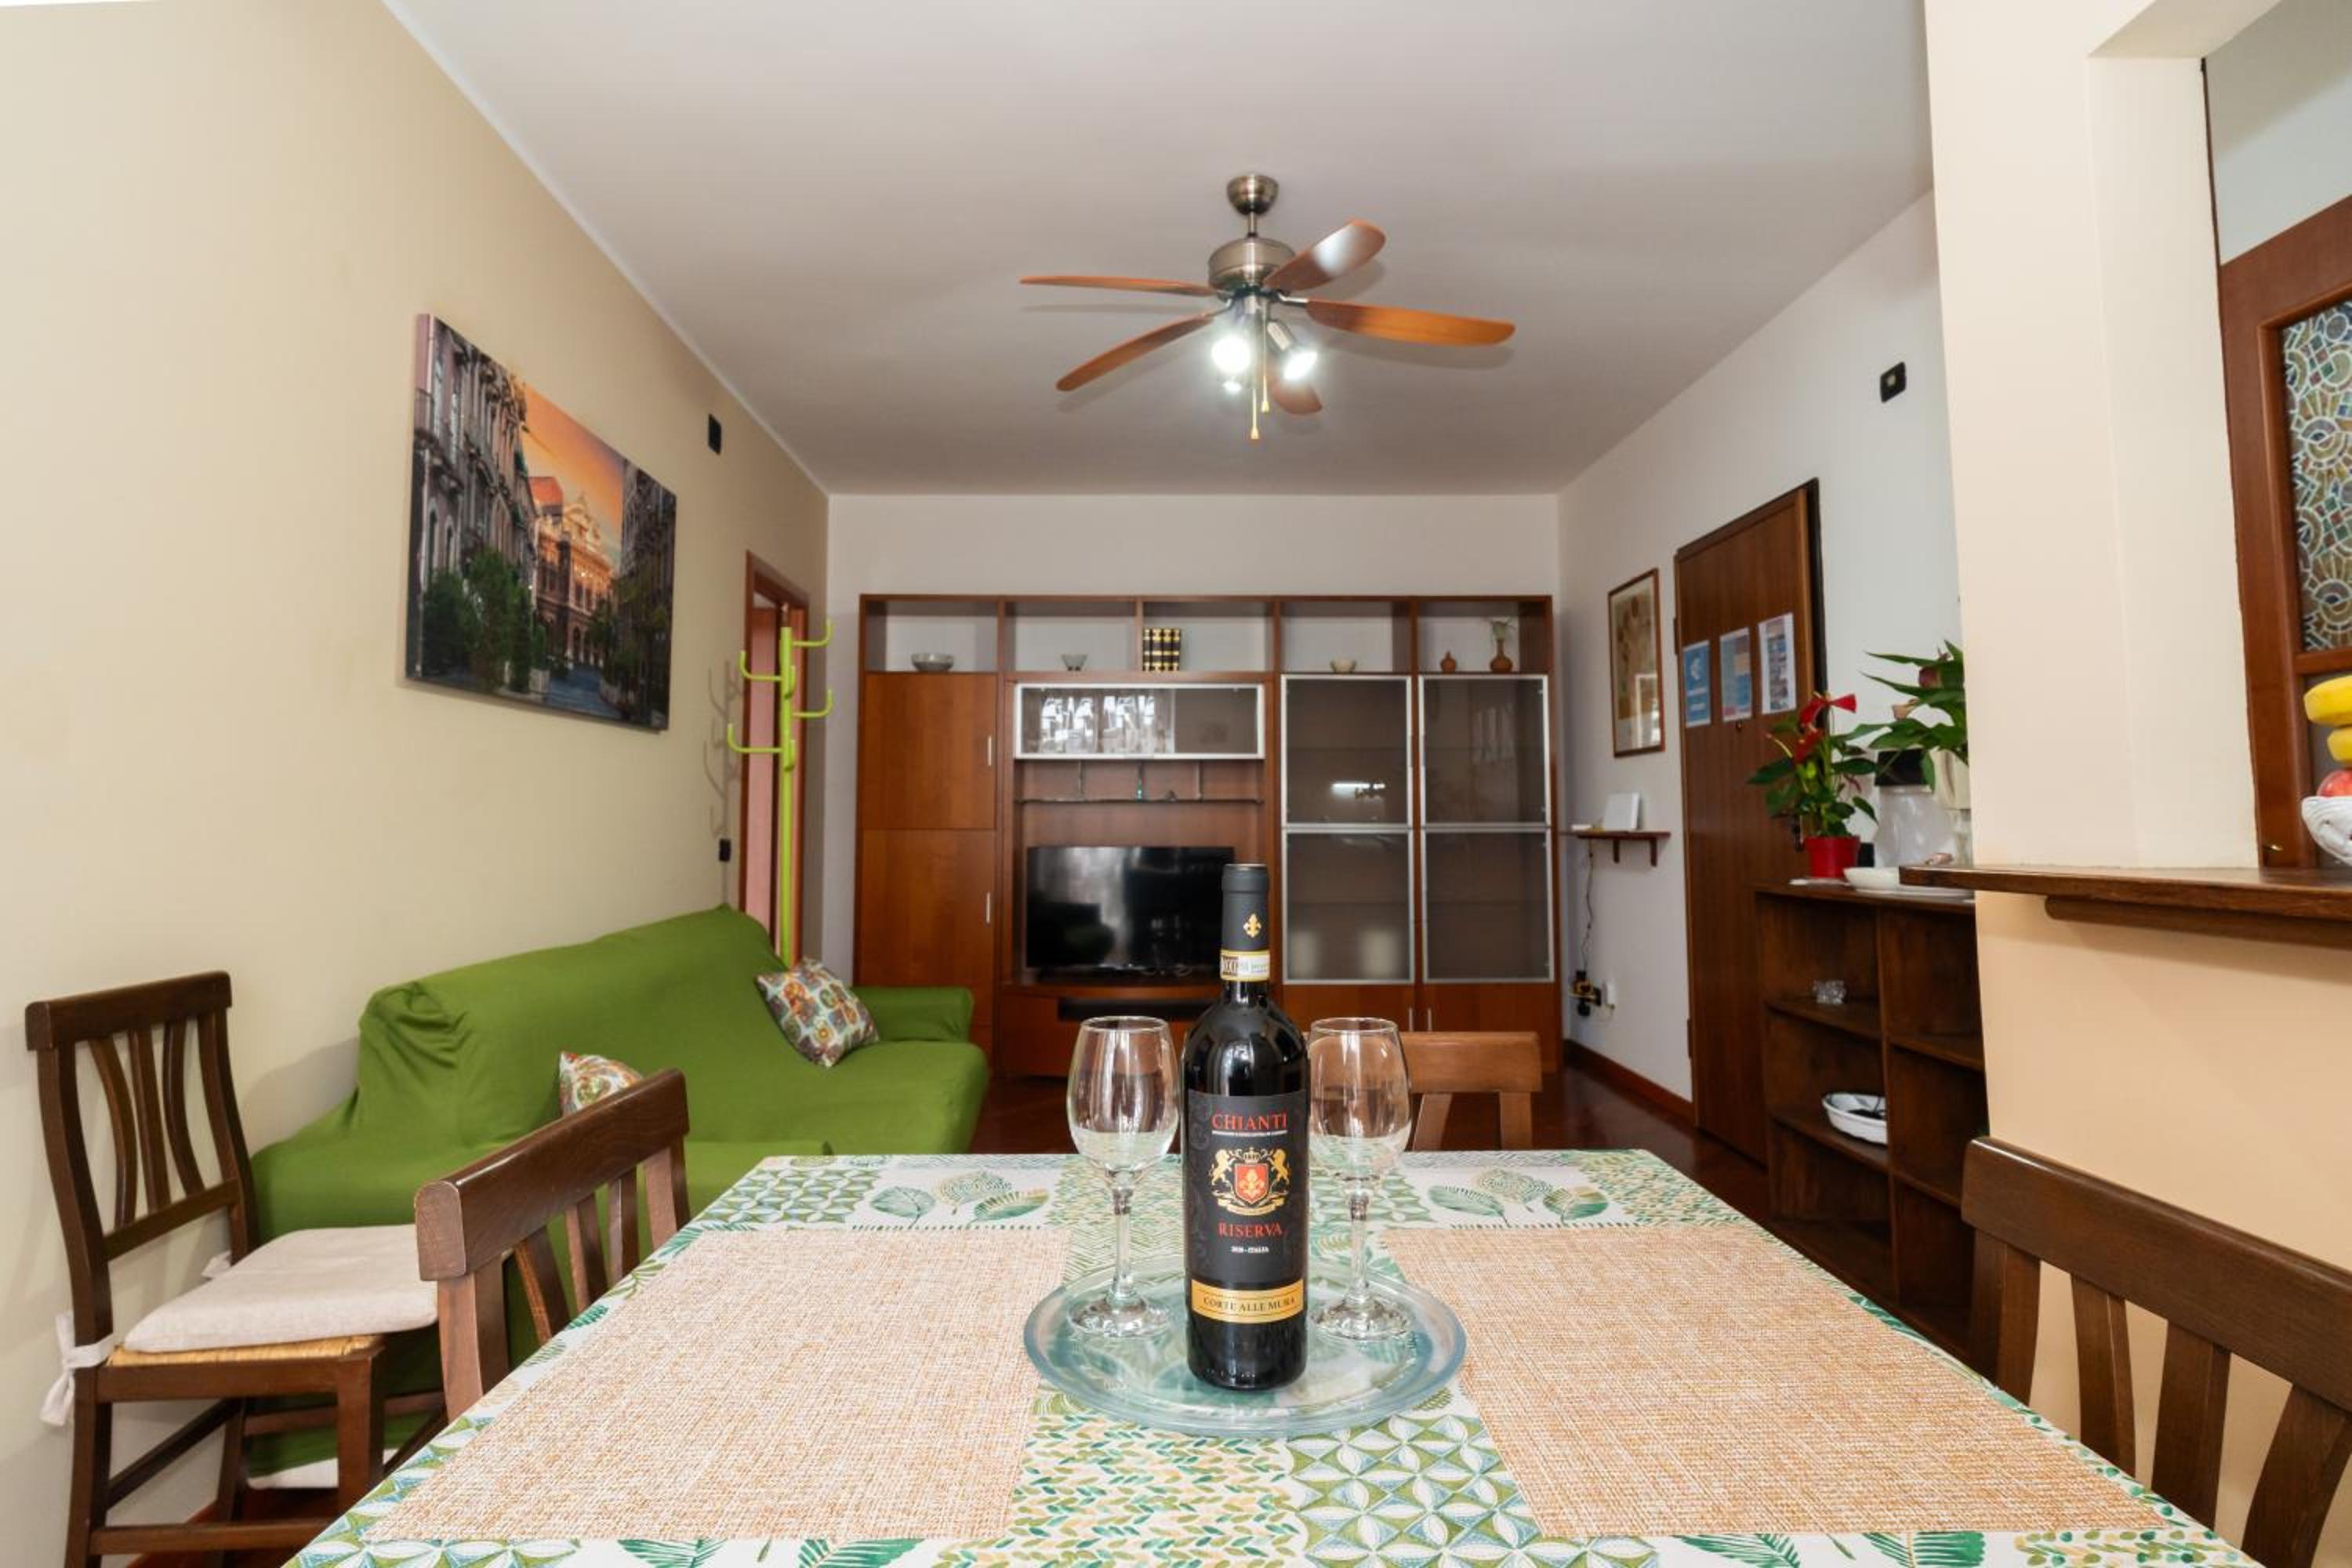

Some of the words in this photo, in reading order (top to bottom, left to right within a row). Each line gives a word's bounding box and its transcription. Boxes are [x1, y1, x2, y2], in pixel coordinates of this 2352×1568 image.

[1212, 1113, 1287, 1130] CHIANTI
[1219, 1222, 1283, 1237] RISERVA
[1204, 1295, 1236, 1310] CORTE
[1238, 1302, 1265, 1312] ALLE
